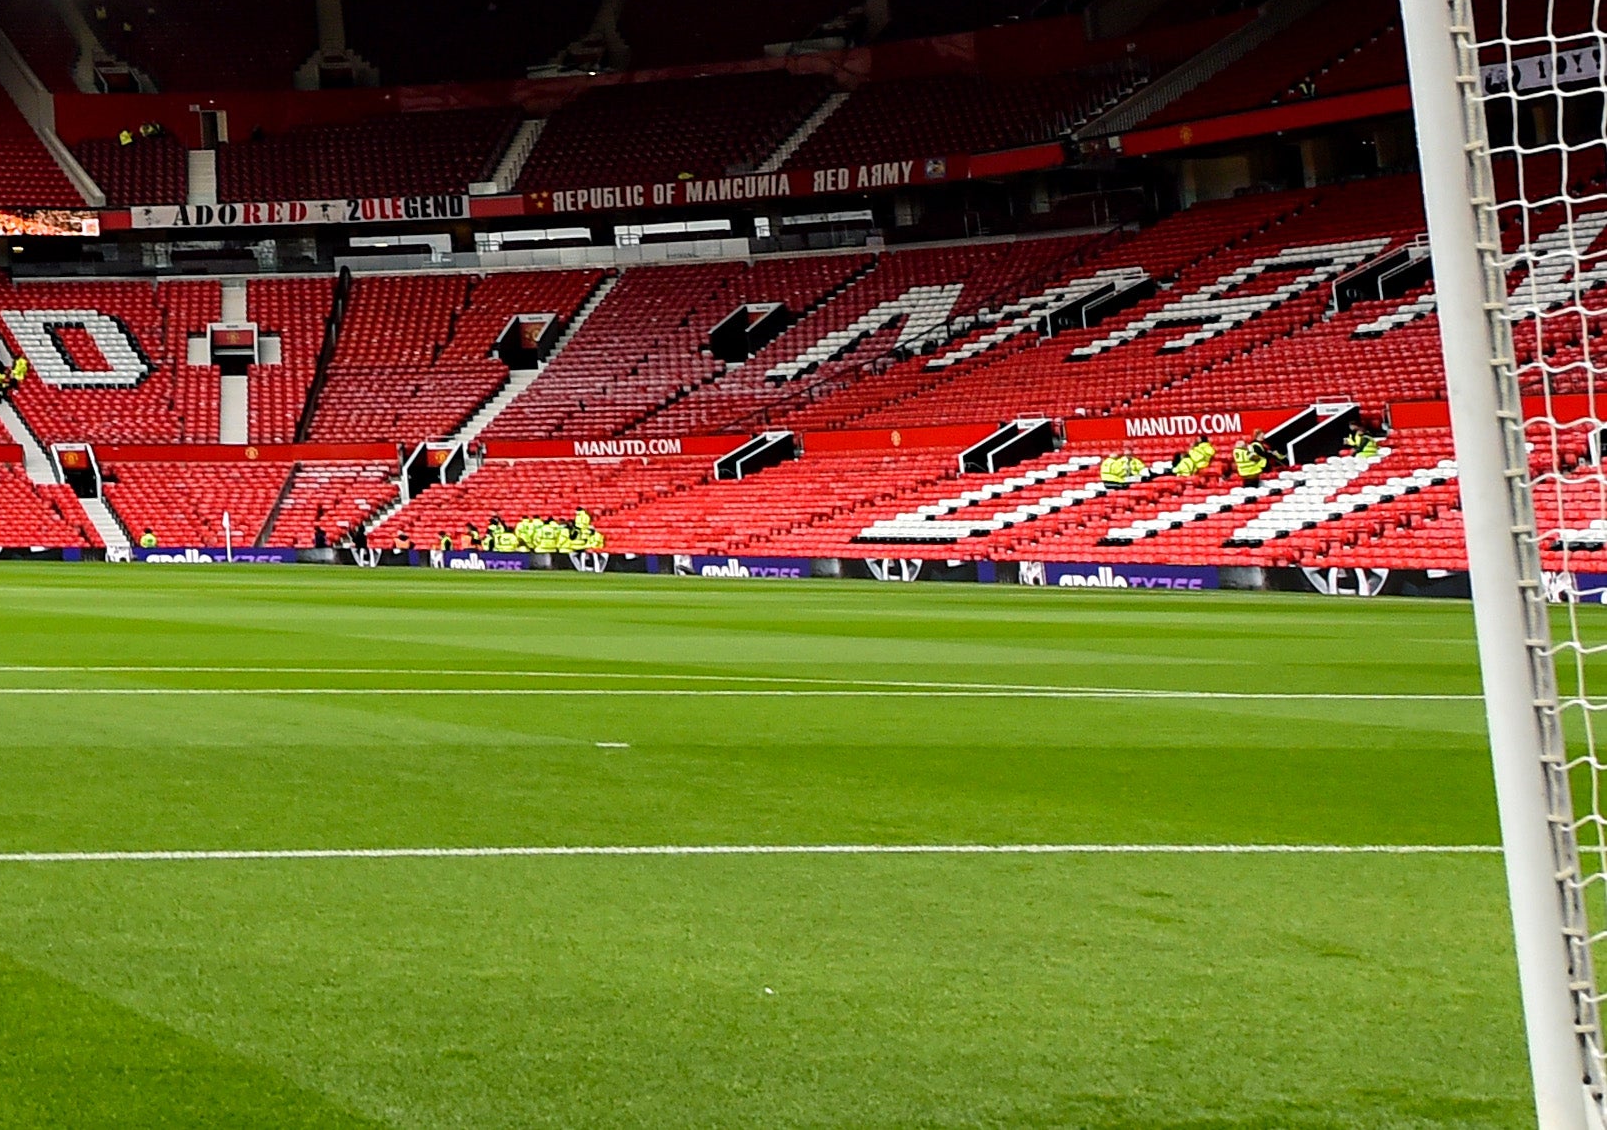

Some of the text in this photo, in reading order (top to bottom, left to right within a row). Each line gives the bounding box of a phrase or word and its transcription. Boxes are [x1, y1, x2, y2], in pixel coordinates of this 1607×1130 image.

[653, 182, 677, 206] OF
[172, 201, 308, 227] ADORED
[1125, 413, 1242, 437] MANUTD.COM
[574, 437, 682, 457] MANUTD.COM
